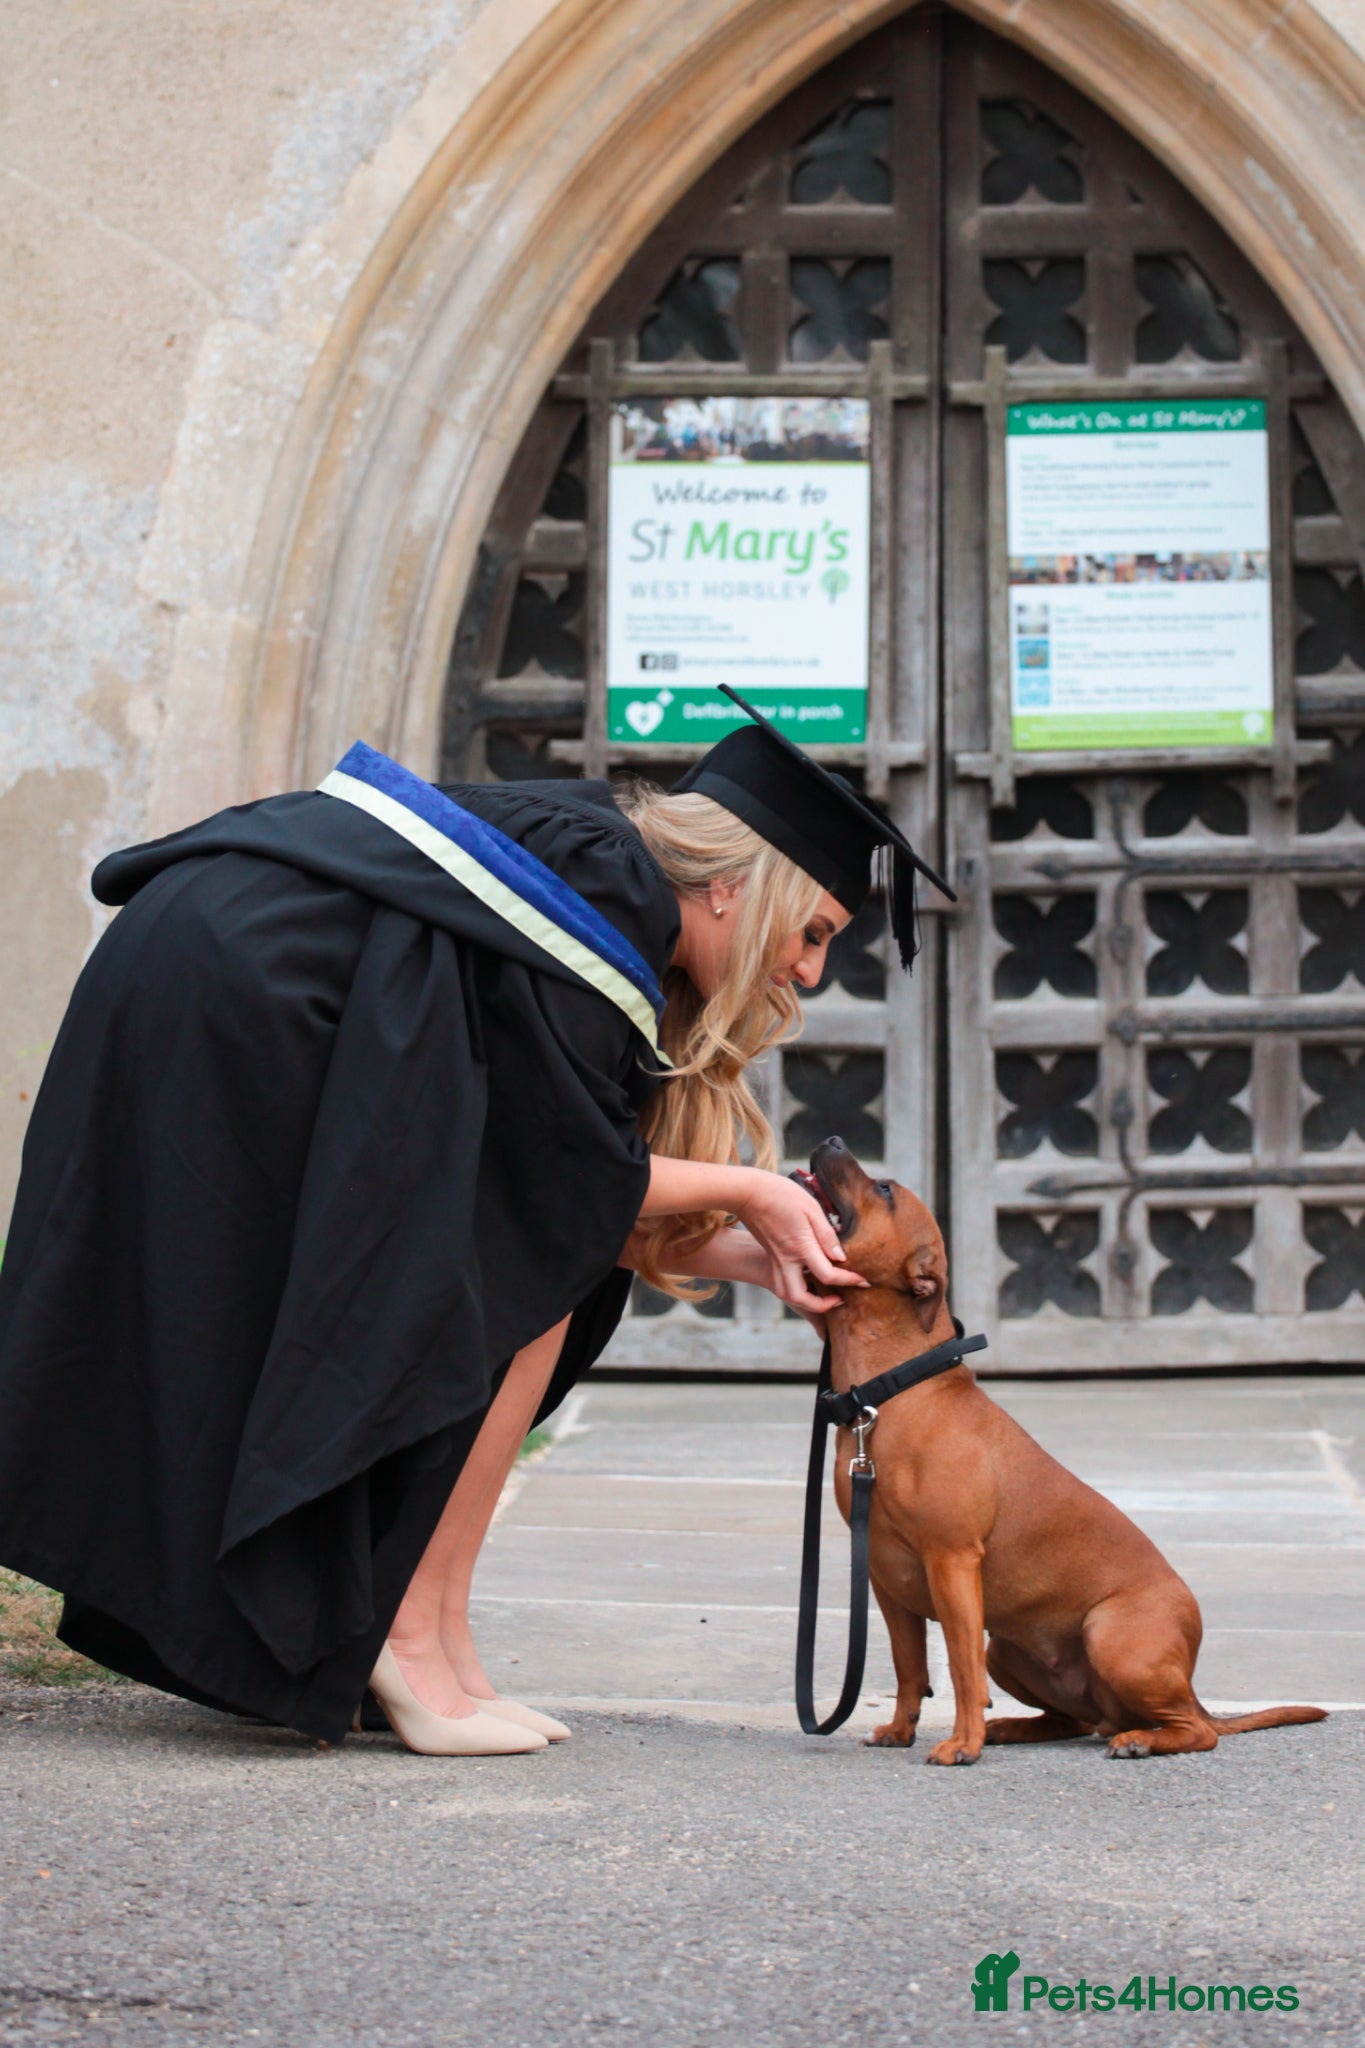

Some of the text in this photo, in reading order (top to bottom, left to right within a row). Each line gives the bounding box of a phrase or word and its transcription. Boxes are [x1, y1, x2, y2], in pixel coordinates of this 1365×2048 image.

[1026, 412, 1092, 430] What's
[1127, 412, 1149, 428] at
[1152, 410, 1174, 428] St
[652, 480, 827, 505] Welcome to
[628, 518, 849, 575] St Mary's
[628, 580, 811, 599] WEST HORSLEY
